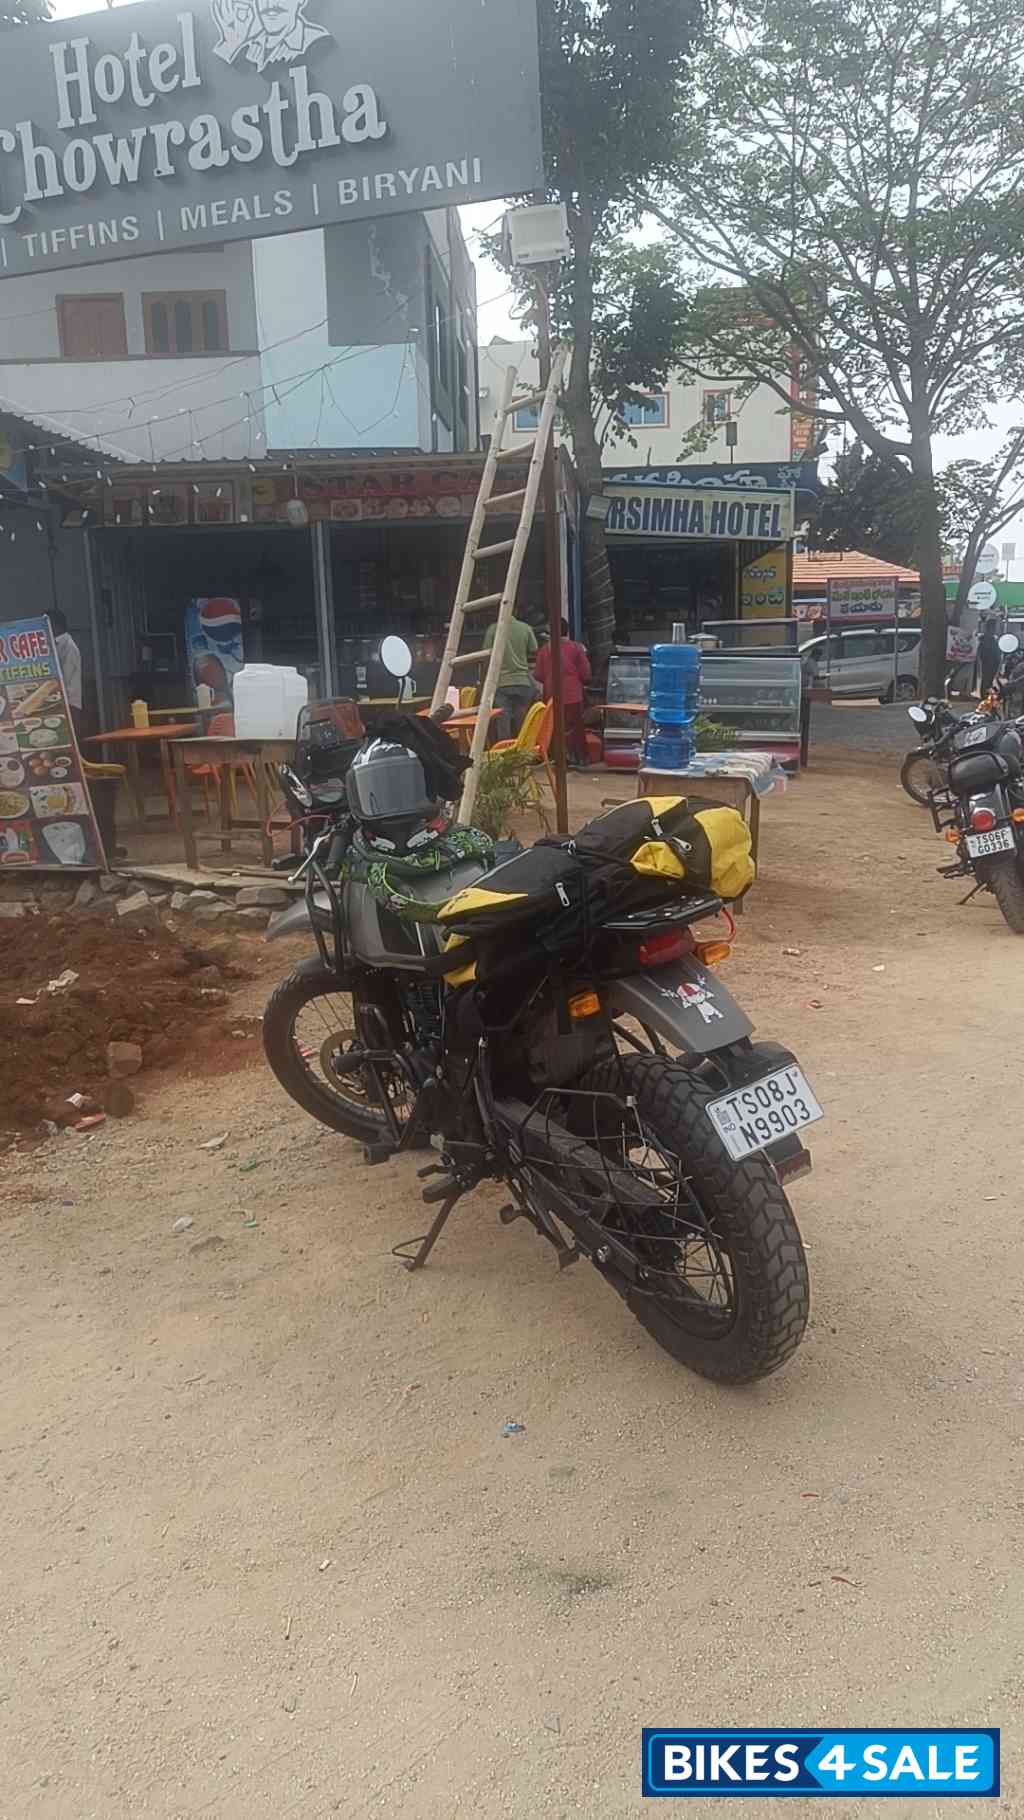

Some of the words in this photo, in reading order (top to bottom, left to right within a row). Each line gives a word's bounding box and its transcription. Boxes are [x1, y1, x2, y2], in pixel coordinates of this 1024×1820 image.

[49, 12, 202, 130] Hotel
[22, 215, 140, 258] TIFFINS
[180, 189, 294, 233] MEALS
[338, 157, 483, 206] BIRYANI
[607, 496, 705, 535] RSIMHA
[709, 501, 783, 539] HOTEL
[9, 631, 49, 659] CAFE
[726, 1072, 798, 1121] TS08J
[739, 1099, 811, 1149] N9903
